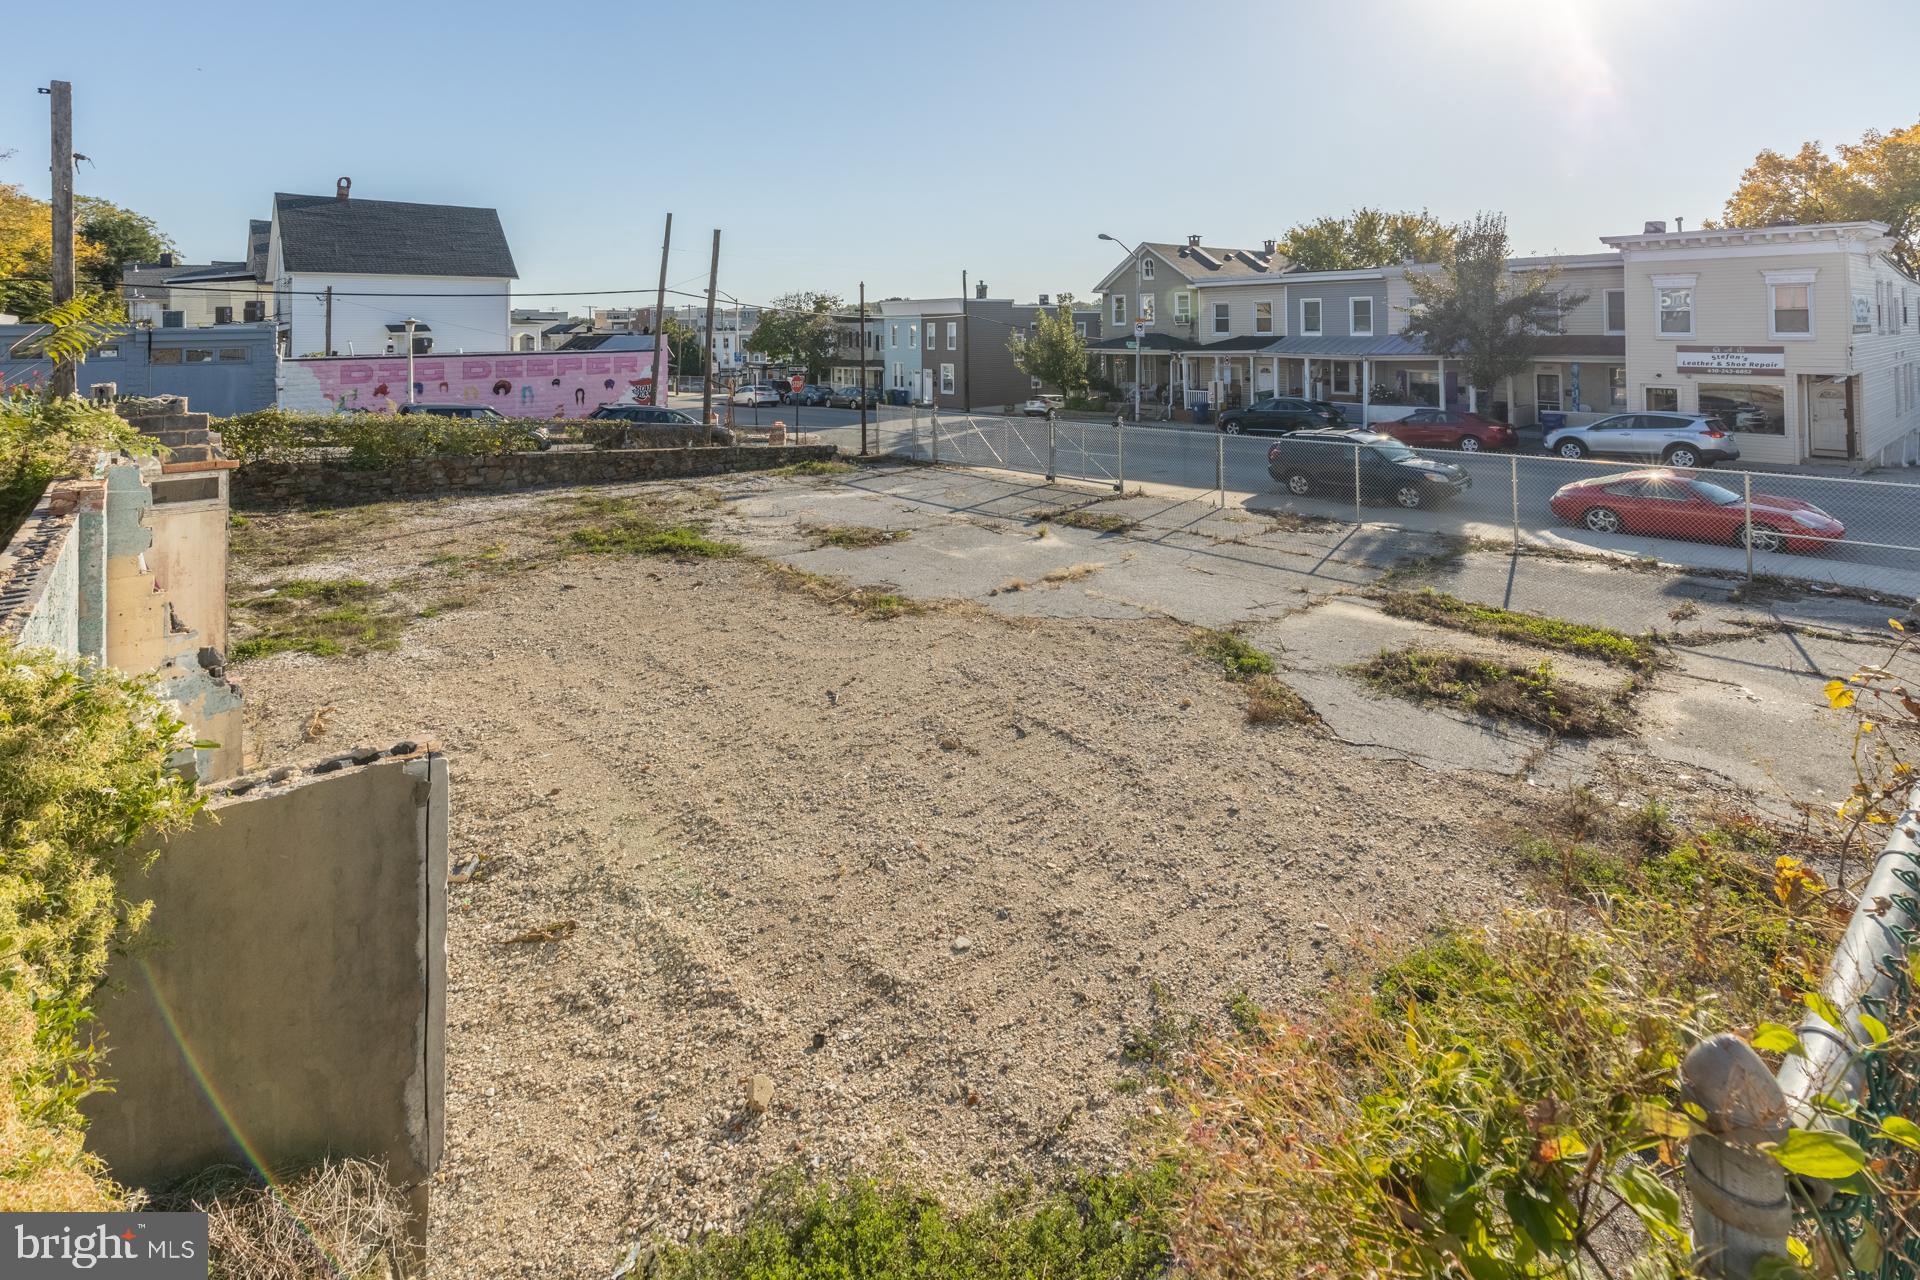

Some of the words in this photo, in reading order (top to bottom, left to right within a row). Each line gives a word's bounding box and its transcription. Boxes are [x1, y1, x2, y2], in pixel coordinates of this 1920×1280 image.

[1711, 353, 1748, 362] Stefan's
[340, 361, 444, 384] DIG
[462, 356, 638, 380] DEEPER
[792, 380, 803, 388] STOP
